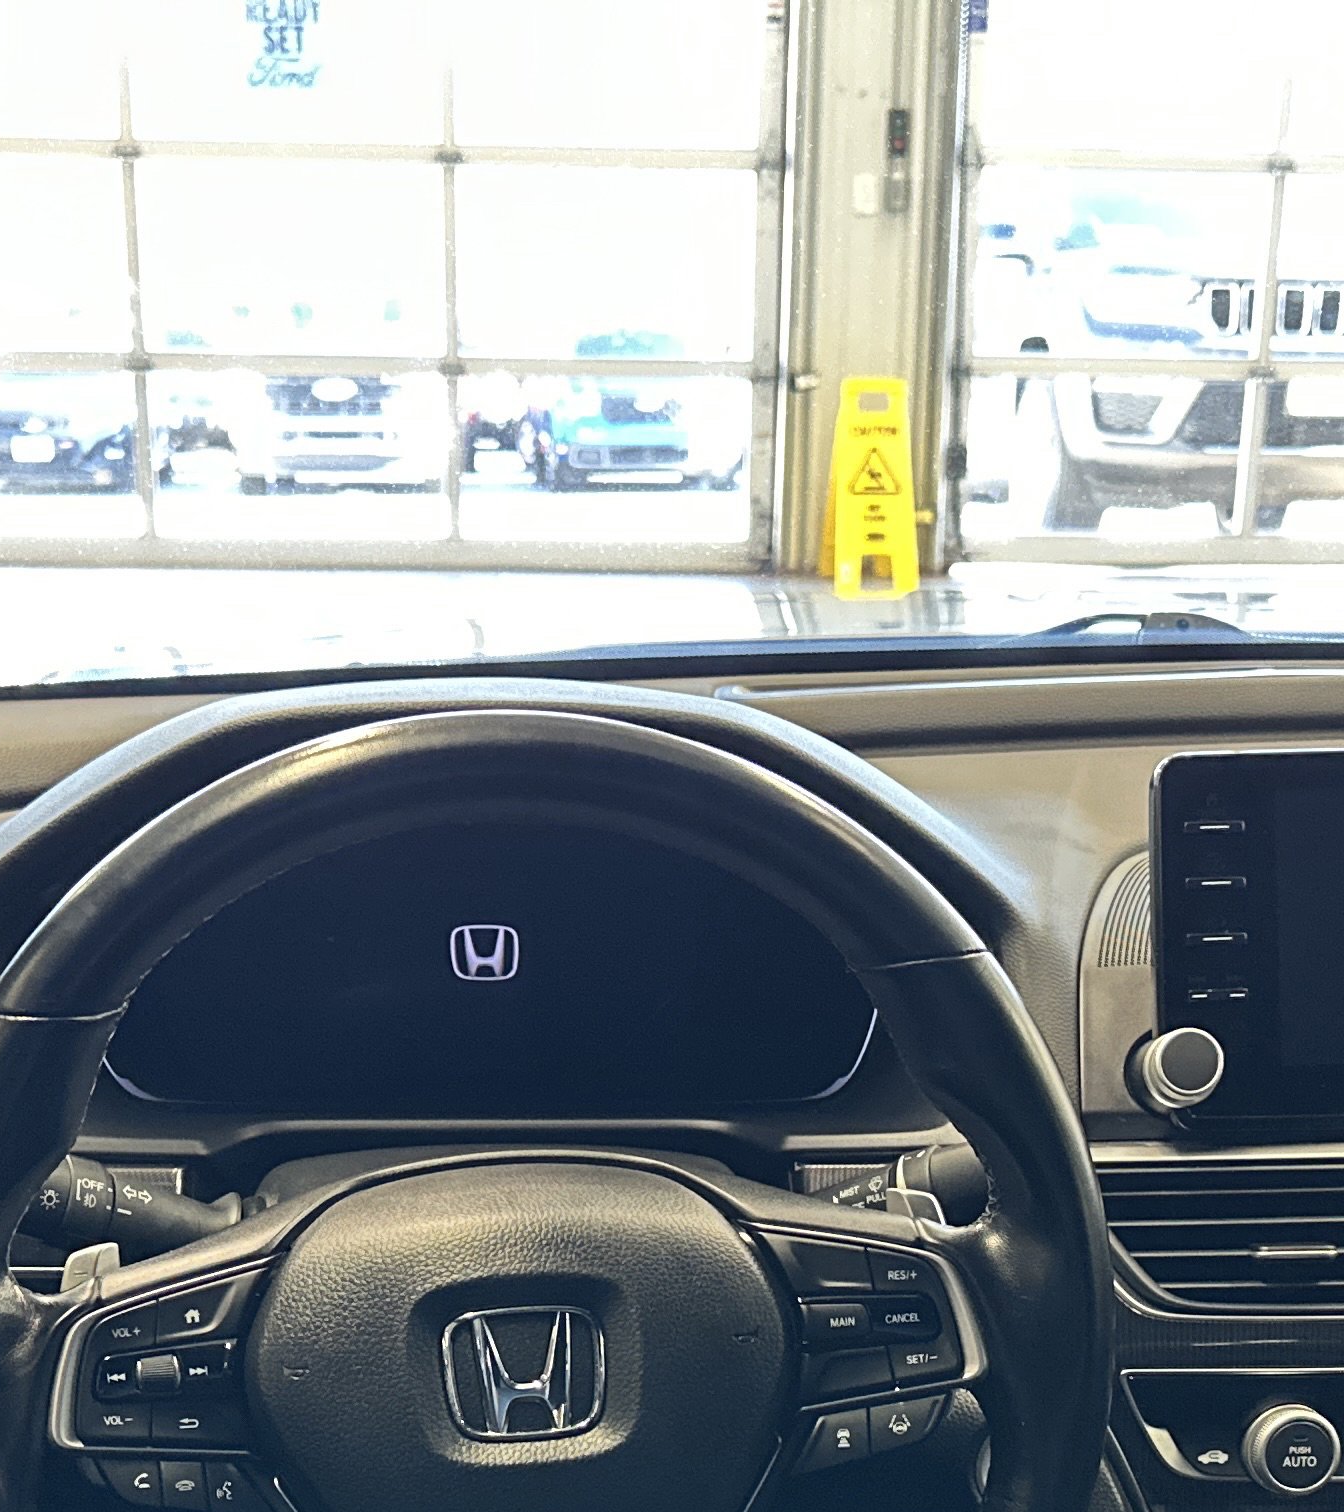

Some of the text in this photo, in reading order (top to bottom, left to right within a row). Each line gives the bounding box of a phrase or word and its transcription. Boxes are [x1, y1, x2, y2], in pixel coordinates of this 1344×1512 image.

[263, 26, 304, 54] SET
[81, 1177, 105, 1192] OFF
[839, 1185, 860, 1198] MIST
[866, 1192, 887, 1204] PULL
[829, 1317, 856, 1328] MAIN
[885, 1312, 921, 1324] CANCEL
[1288, 1445, 1312, 1455] PUSH
[1282, 1455, 1318, 1468] AUTO
